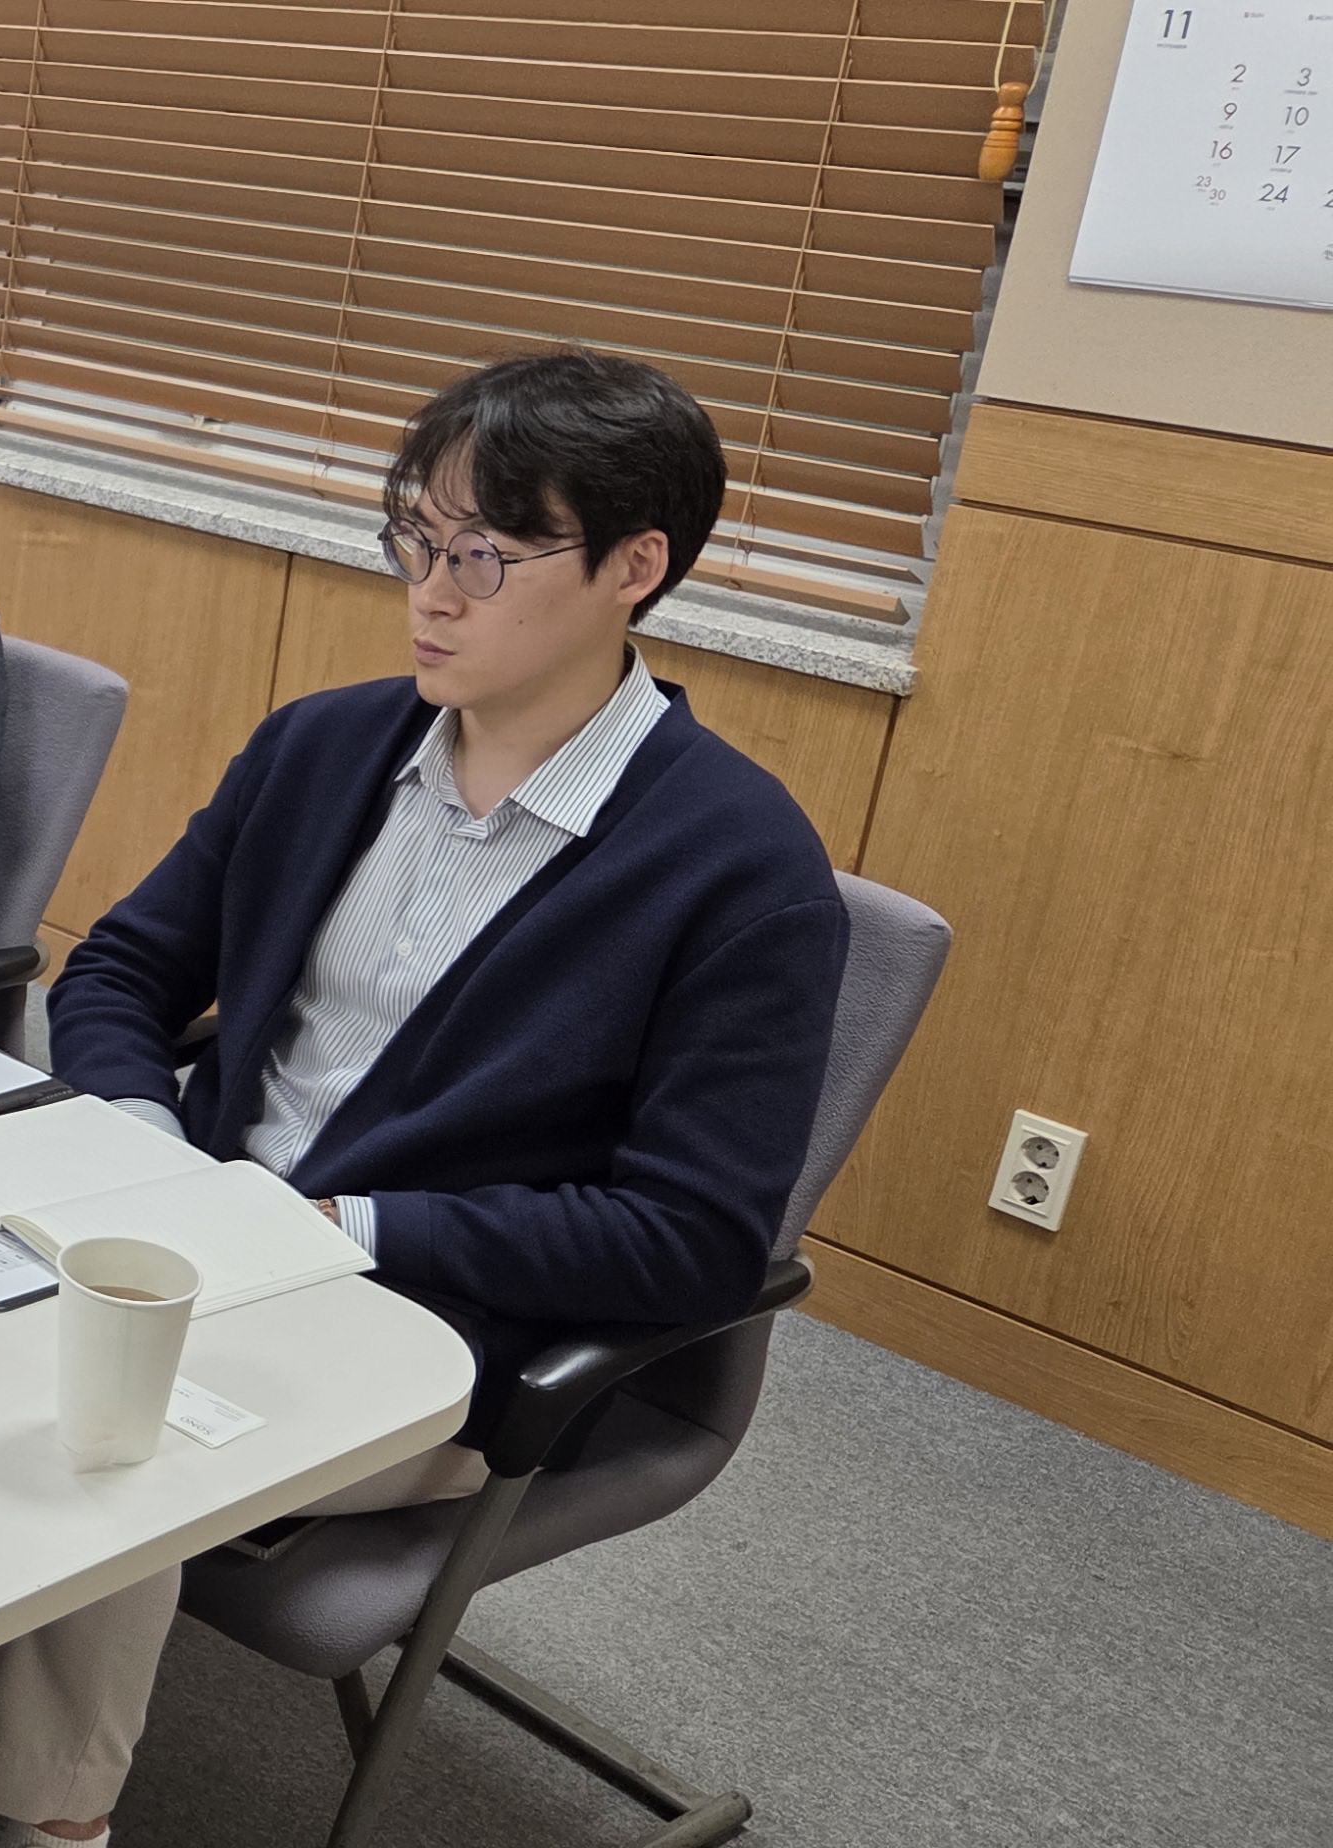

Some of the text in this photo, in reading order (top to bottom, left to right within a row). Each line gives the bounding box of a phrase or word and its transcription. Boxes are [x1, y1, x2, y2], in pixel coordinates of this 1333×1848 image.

[1162, 10, 1193, 39] 11
[1231, 64, 1312, 87] 2 3
[1223, 102, 1309, 126] 9 10
[1210, 140, 1302, 164] 16 17
[1195, 176, 1212, 187] 23
[1258, 183, 1290, 203] 24
[1209, 189, 1226, 200] 30
